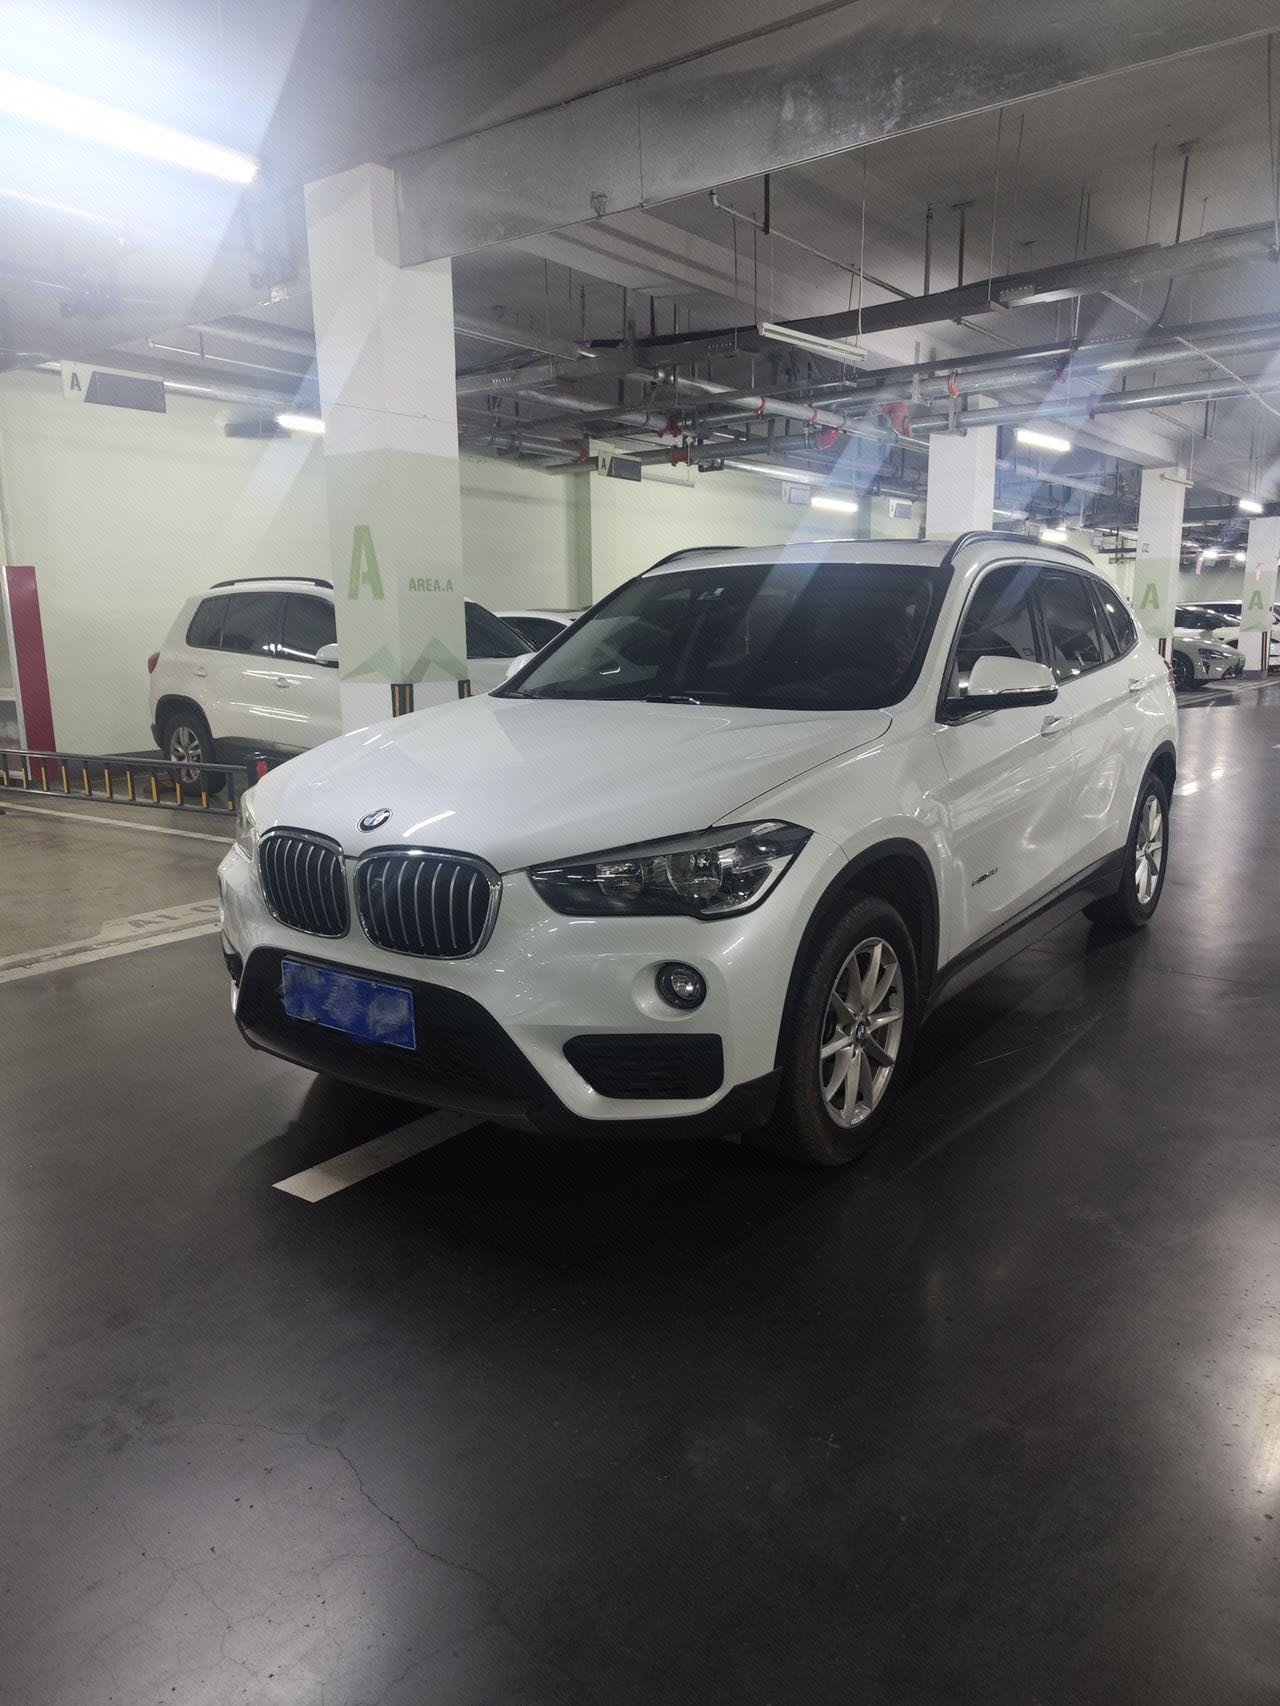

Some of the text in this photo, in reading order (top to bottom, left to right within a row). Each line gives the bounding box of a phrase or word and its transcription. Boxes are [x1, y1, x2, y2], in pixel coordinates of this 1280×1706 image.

[70, 372, 82, 391] A
[601, 457, 607, 470] A
[348, 525, 384, 600] A
[408, 578, 454, 592] AREA.A
[1140, 583, 1159, 609] A
[1247, 590, 1263, 610] A
